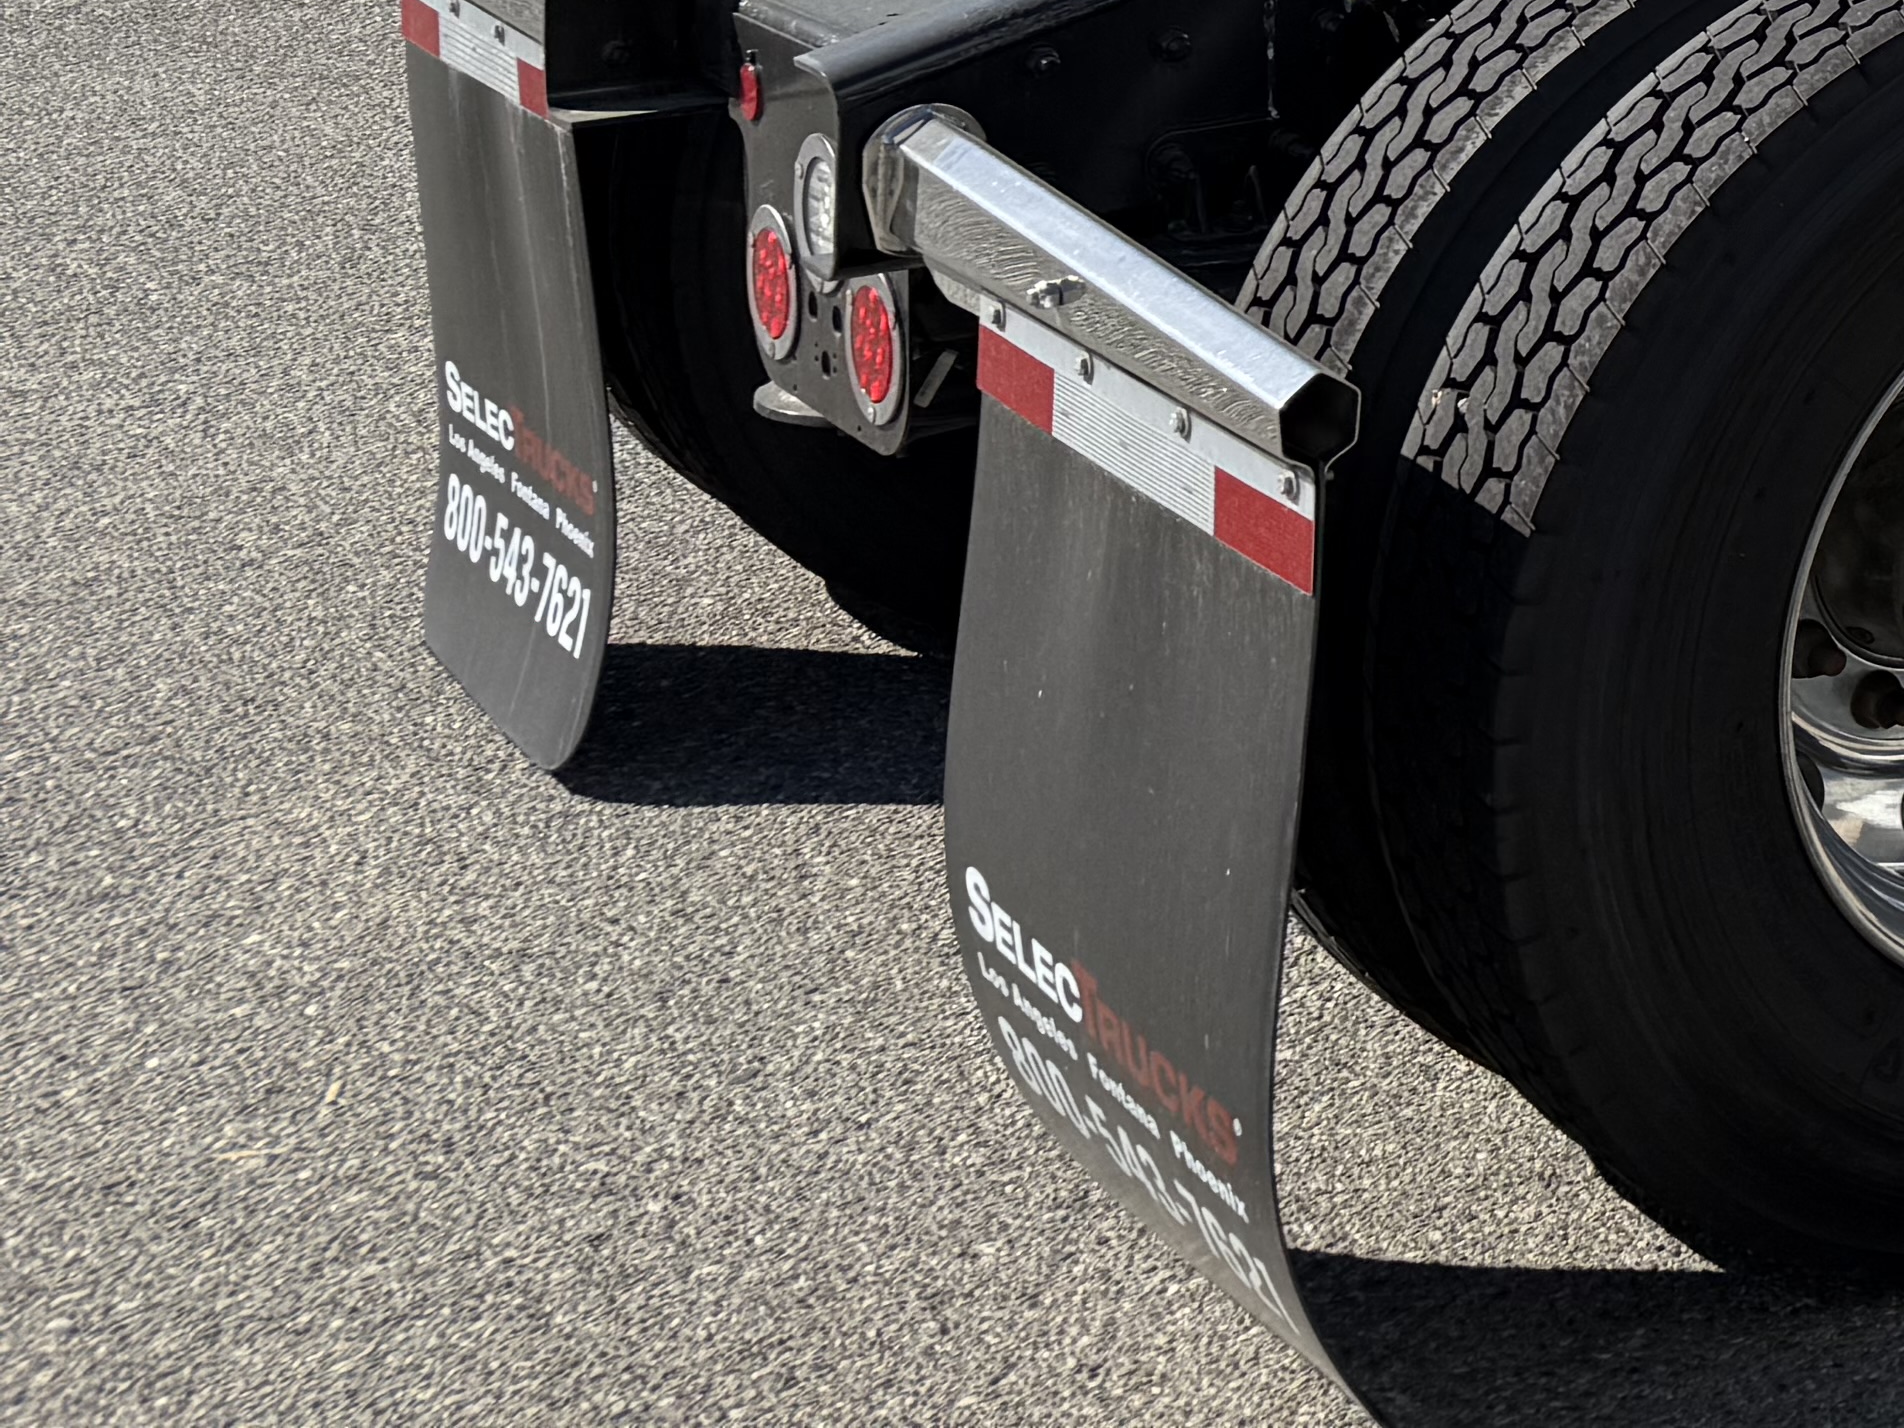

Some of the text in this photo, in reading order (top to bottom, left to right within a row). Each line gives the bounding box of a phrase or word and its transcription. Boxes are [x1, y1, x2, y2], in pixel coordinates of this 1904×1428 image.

[444, 473, 592, 660] 800-543-7621
[449, 424, 594, 559] Los Angeles Fontana Phoenix
[977, 952, 1250, 1224] Los Angeles Fontana Phoenix
[998, 1016, 1301, 1336] 800-543-7621
